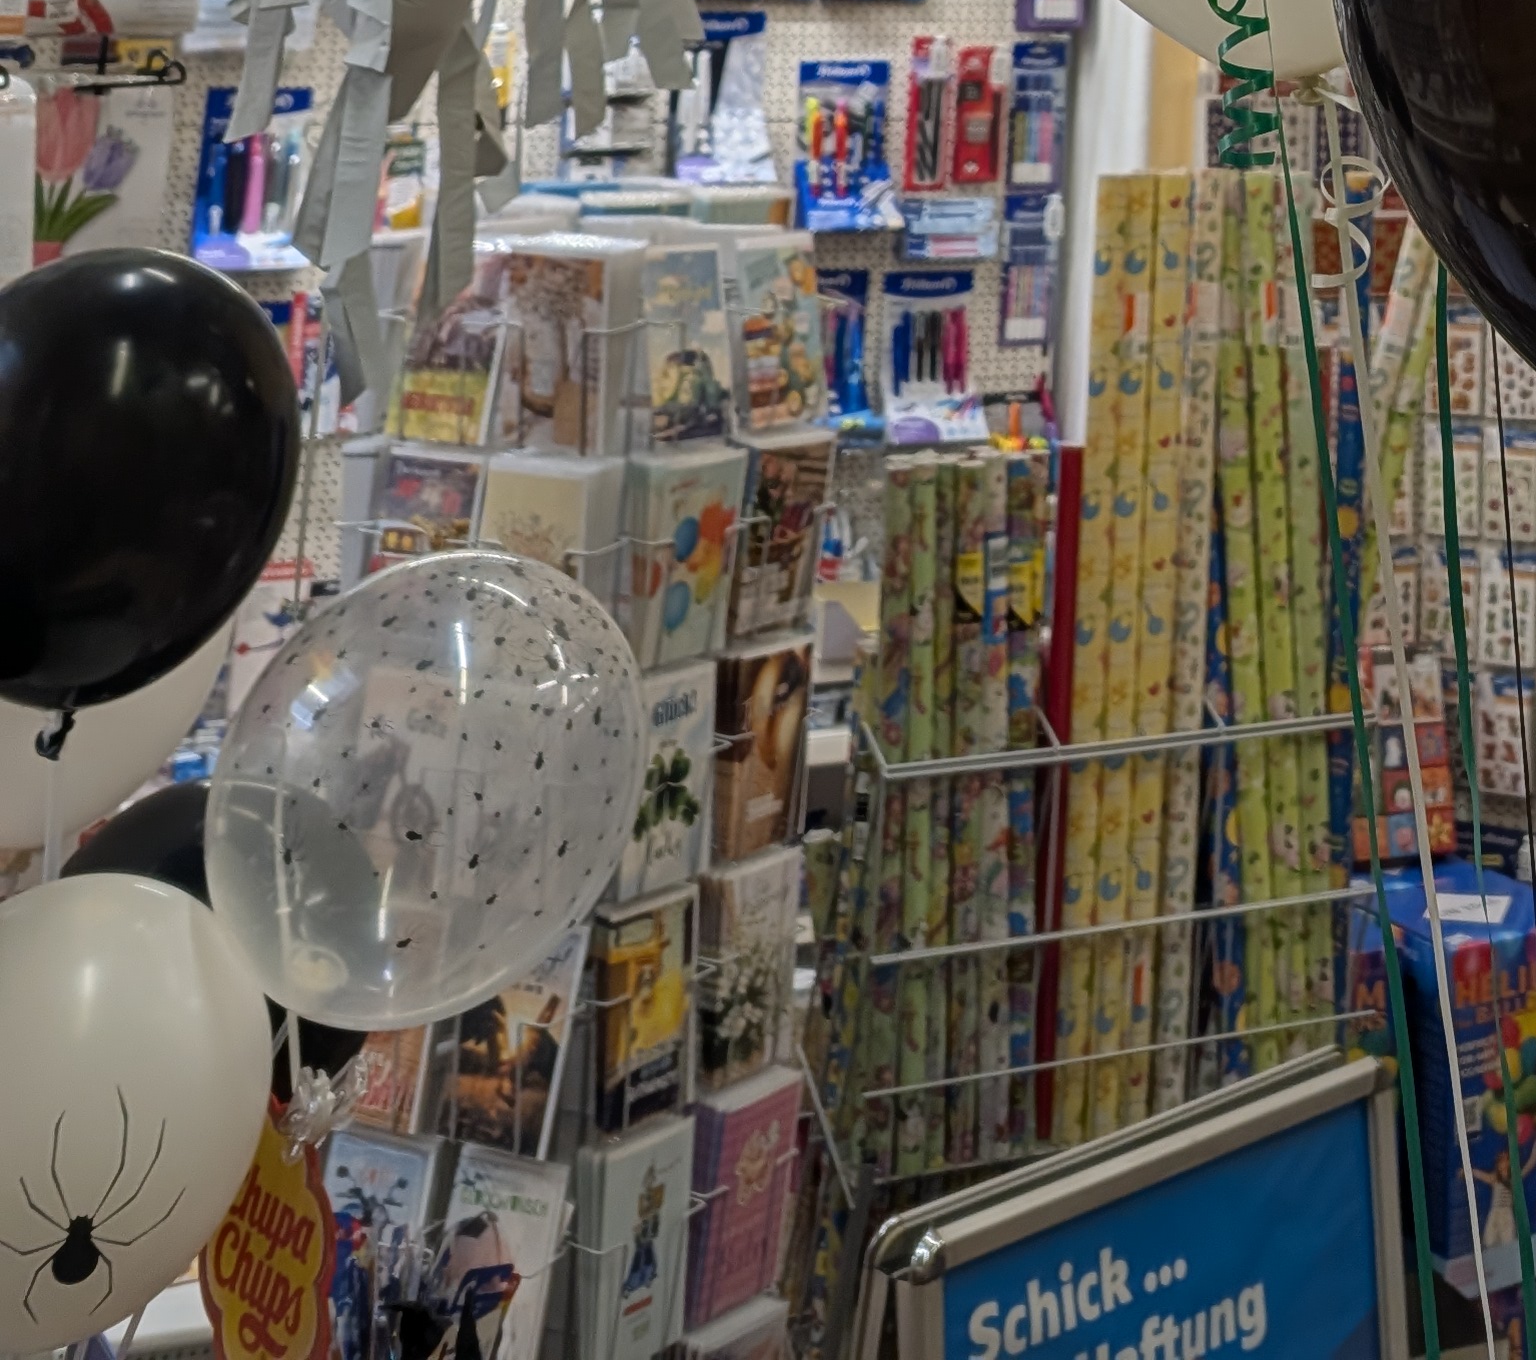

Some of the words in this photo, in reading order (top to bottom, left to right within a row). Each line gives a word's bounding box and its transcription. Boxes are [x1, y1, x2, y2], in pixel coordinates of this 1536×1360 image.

[231, 1165, 316, 1266] hupa
[213, 1220, 305, 1337] Chups
[968, 1246, 1134, 1360] Schick
